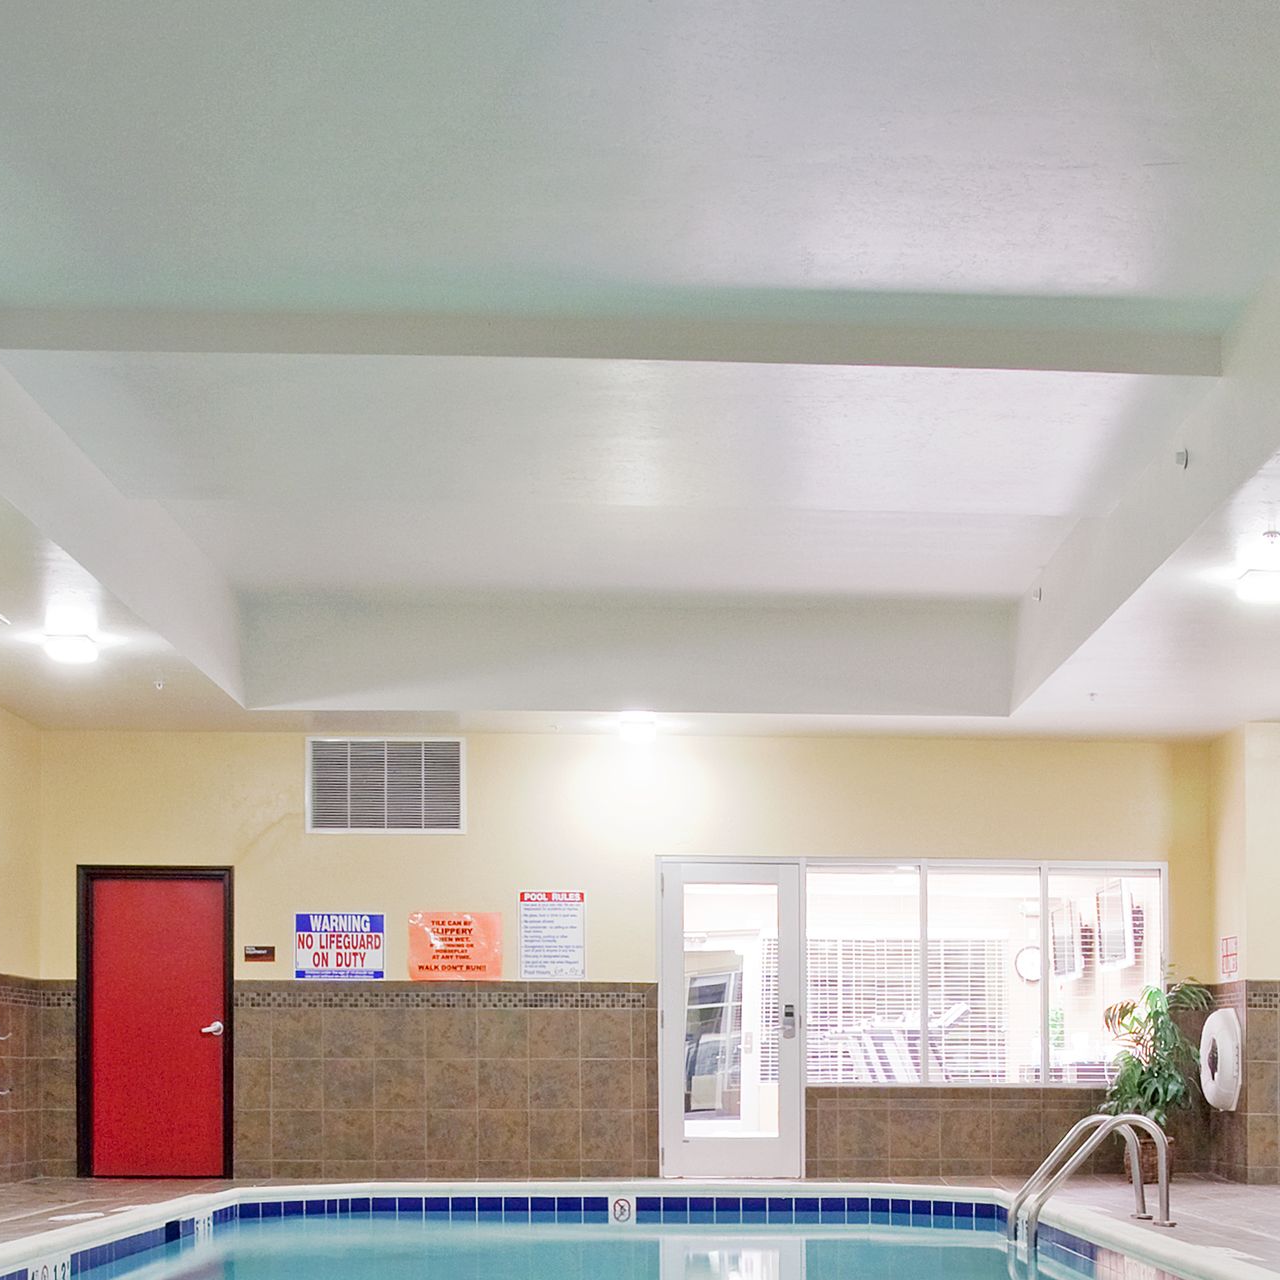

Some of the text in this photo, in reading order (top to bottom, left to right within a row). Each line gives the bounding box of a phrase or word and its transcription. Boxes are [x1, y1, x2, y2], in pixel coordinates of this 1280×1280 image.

[524, 893, 581, 901] POOL RULES
[309, 914, 371, 932] WARNING
[298, 933, 382, 950] NO LIFEGUARD
[312, 951, 366, 968] ON DUTY
[418, 964, 439, 972] WALK
